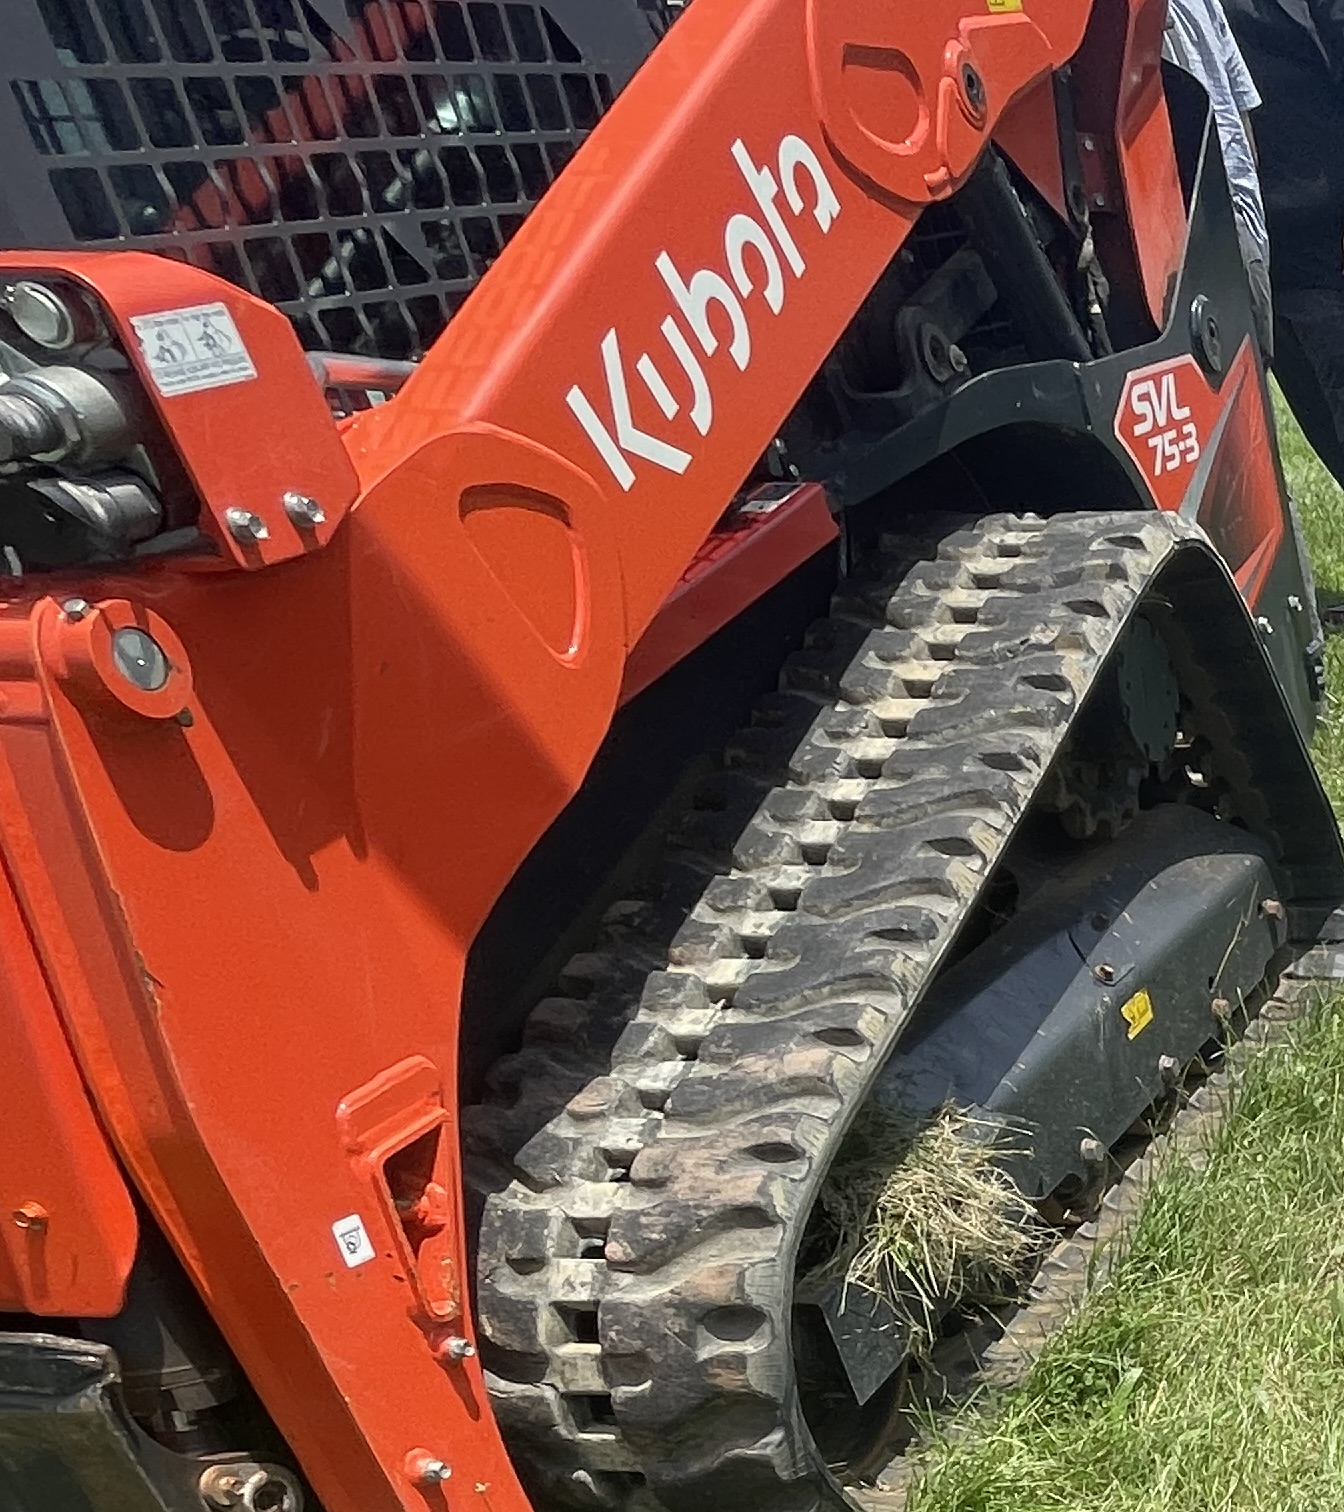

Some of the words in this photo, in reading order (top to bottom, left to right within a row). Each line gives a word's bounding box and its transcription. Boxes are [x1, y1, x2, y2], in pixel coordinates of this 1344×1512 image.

[565, 134, 842, 492] Kubota
[1131, 373, 1191, 437] SVL
[1148, 422, 1200, 476] 75-3
